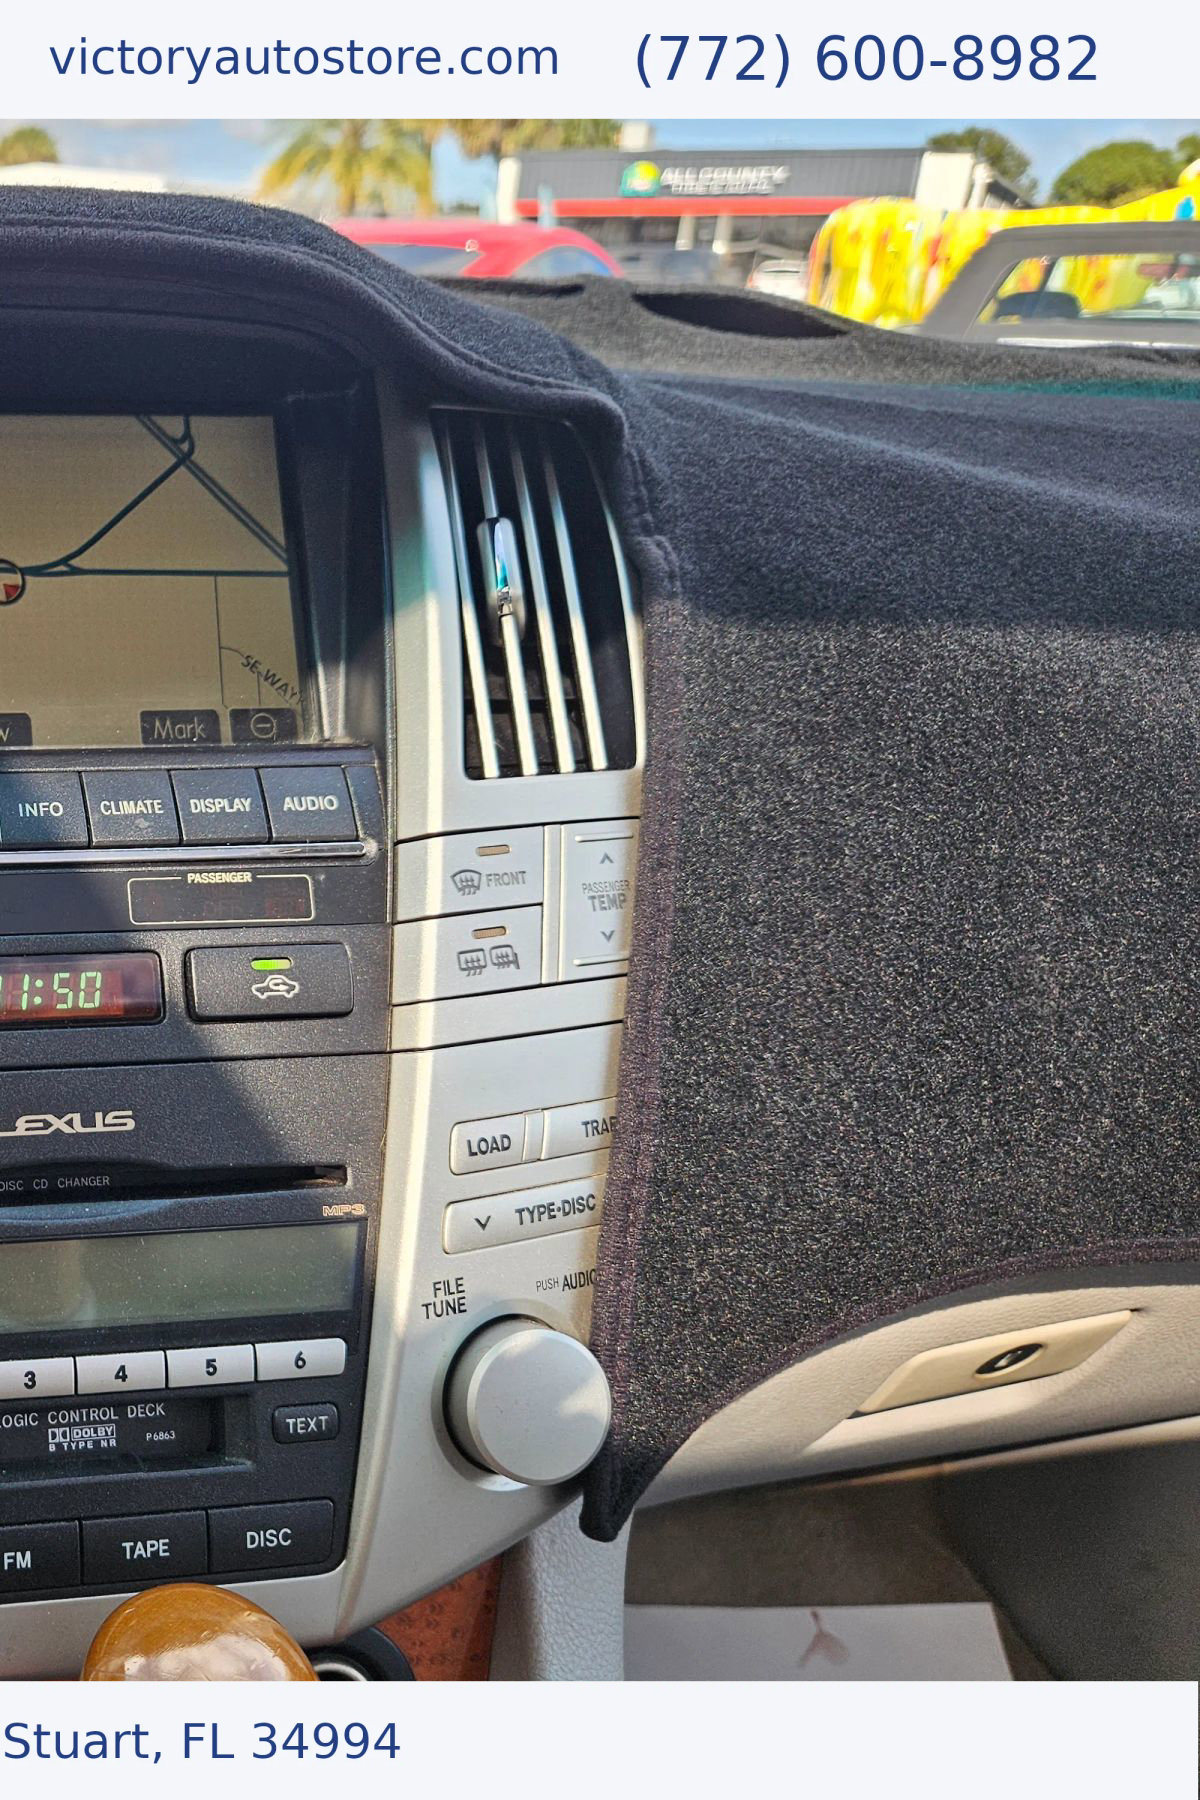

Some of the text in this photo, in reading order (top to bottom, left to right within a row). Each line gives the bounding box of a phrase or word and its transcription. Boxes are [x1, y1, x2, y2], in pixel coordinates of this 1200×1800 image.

[241, 655, 261, 674] SE
[154, 718, 206, 741] Mark
[18, 802, 64, 817] INFO
[100, 799, 164, 815] CLIMATE
[190, 797, 252, 814] DISPLAY
[282, 795, 339, 811] AUDIO
[187, 871, 252, 884] PASSENGER
[485, 870, 527, 888] FRONT
[581, 879, 632, 894] PASSENGER
[587, 892, 627, 912] TEMP
[466, 1133, 512, 1157] LOAD
[32, 1178, 49, 1190] CD
[57, 1175, 111, 1188] CHANGER
[322, 1203, 366, 1217] MP3
[432, 1276, 466, 1299] FILE
[535, 1276, 560, 1293] PUSH
[421, 1296, 467, 1320] TUNE
[205, 1358, 218, 1376] 5
[294, 1351, 307, 1370] 6
[23, 1370, 37, 1390] 3
[114, 1364, 128, 1383] 4
[47, 1406, 119, 1425] CONTROL
[127, 1402, 166, 1418] DECK
[73, 1425, 114, 1439] DOLBY
[285, 1415, 329, 1434] TEXT
[146, 1430, 176, 1441] P6863
[49, 1438, 117, 1452] B TYPE NR
[246, 1527, 292, 1549] DISC
[121, 1538, 171, 1560] TAPE
[3, 1550, 32, 1570] FM
